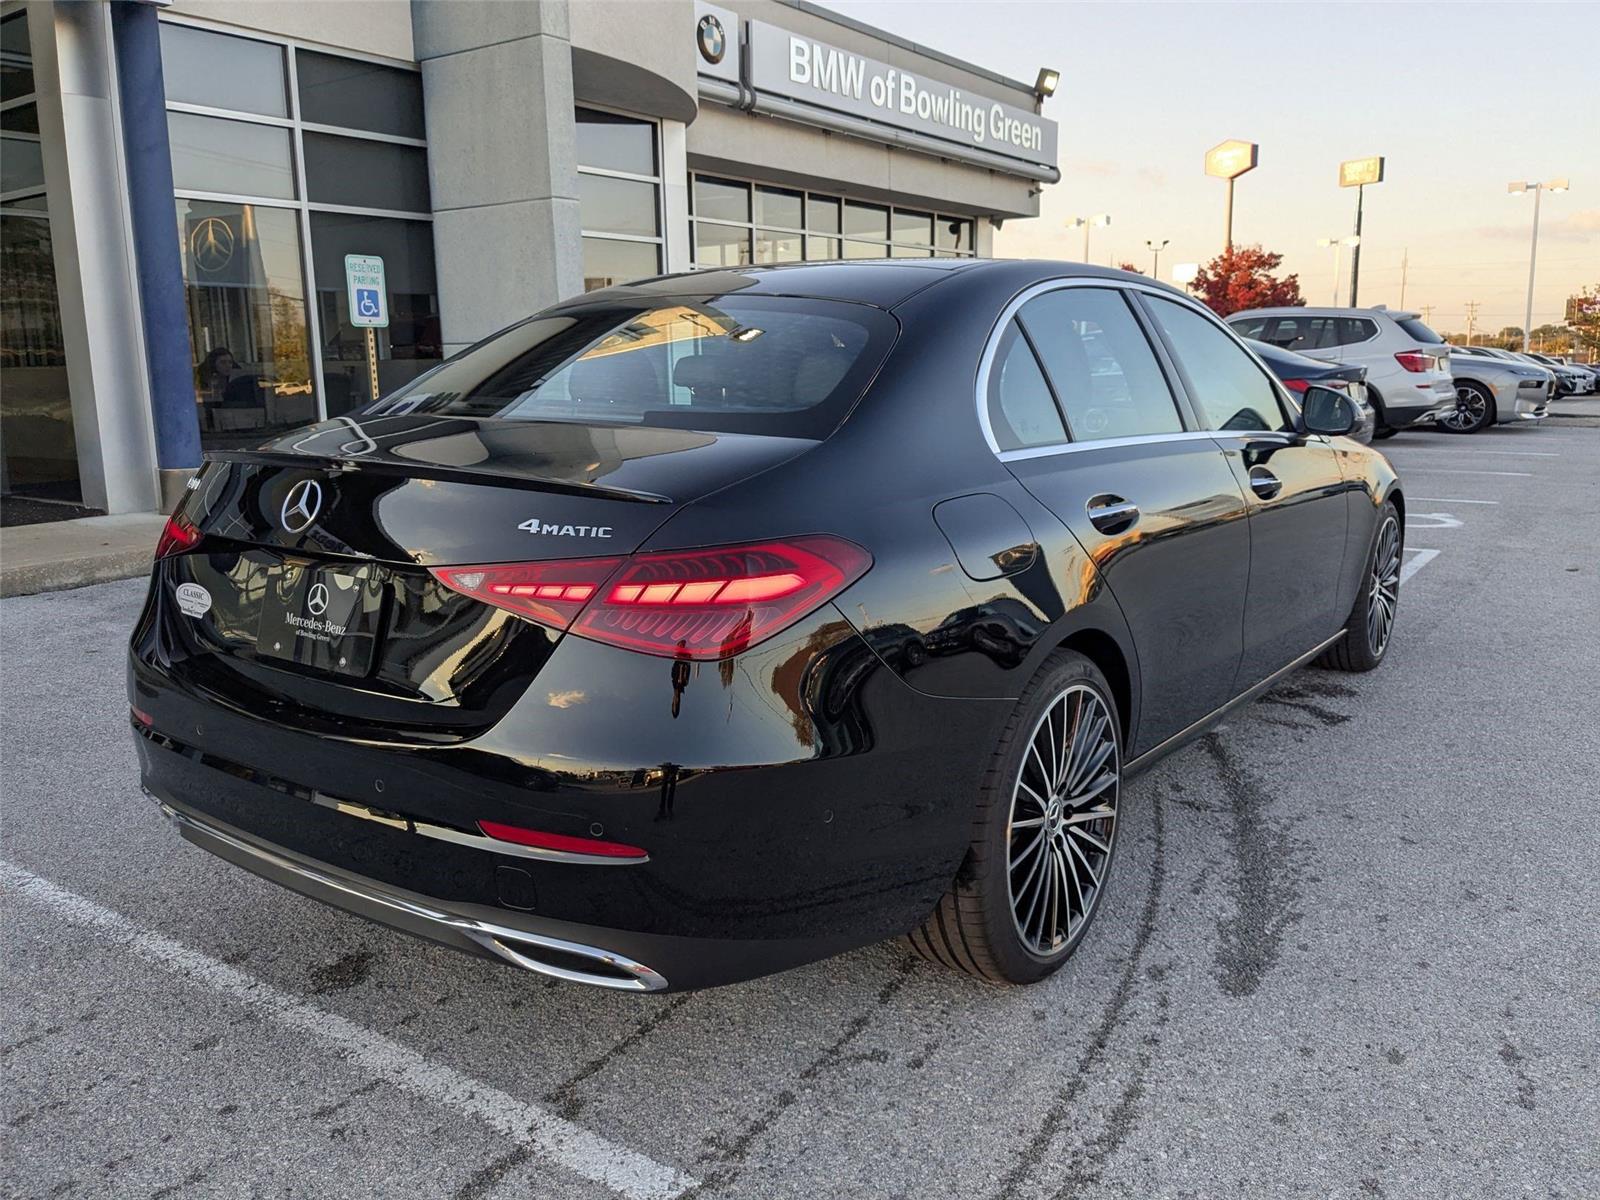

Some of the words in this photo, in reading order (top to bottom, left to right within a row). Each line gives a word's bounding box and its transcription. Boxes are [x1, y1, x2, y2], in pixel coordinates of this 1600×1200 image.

[700, 16, 724, 35] BMW
[789, 36, 866, 100] BMW
[870, 69, 896, 109] of
[899, 73, 986, 143] Bowling
[989, 103, 1042, 151] Green
[517, 518, 613, 538] 4MATIC
[183, 588, 205, 600] CLASSIC
[285, 611, 346, 636] Mercedes-Benz
